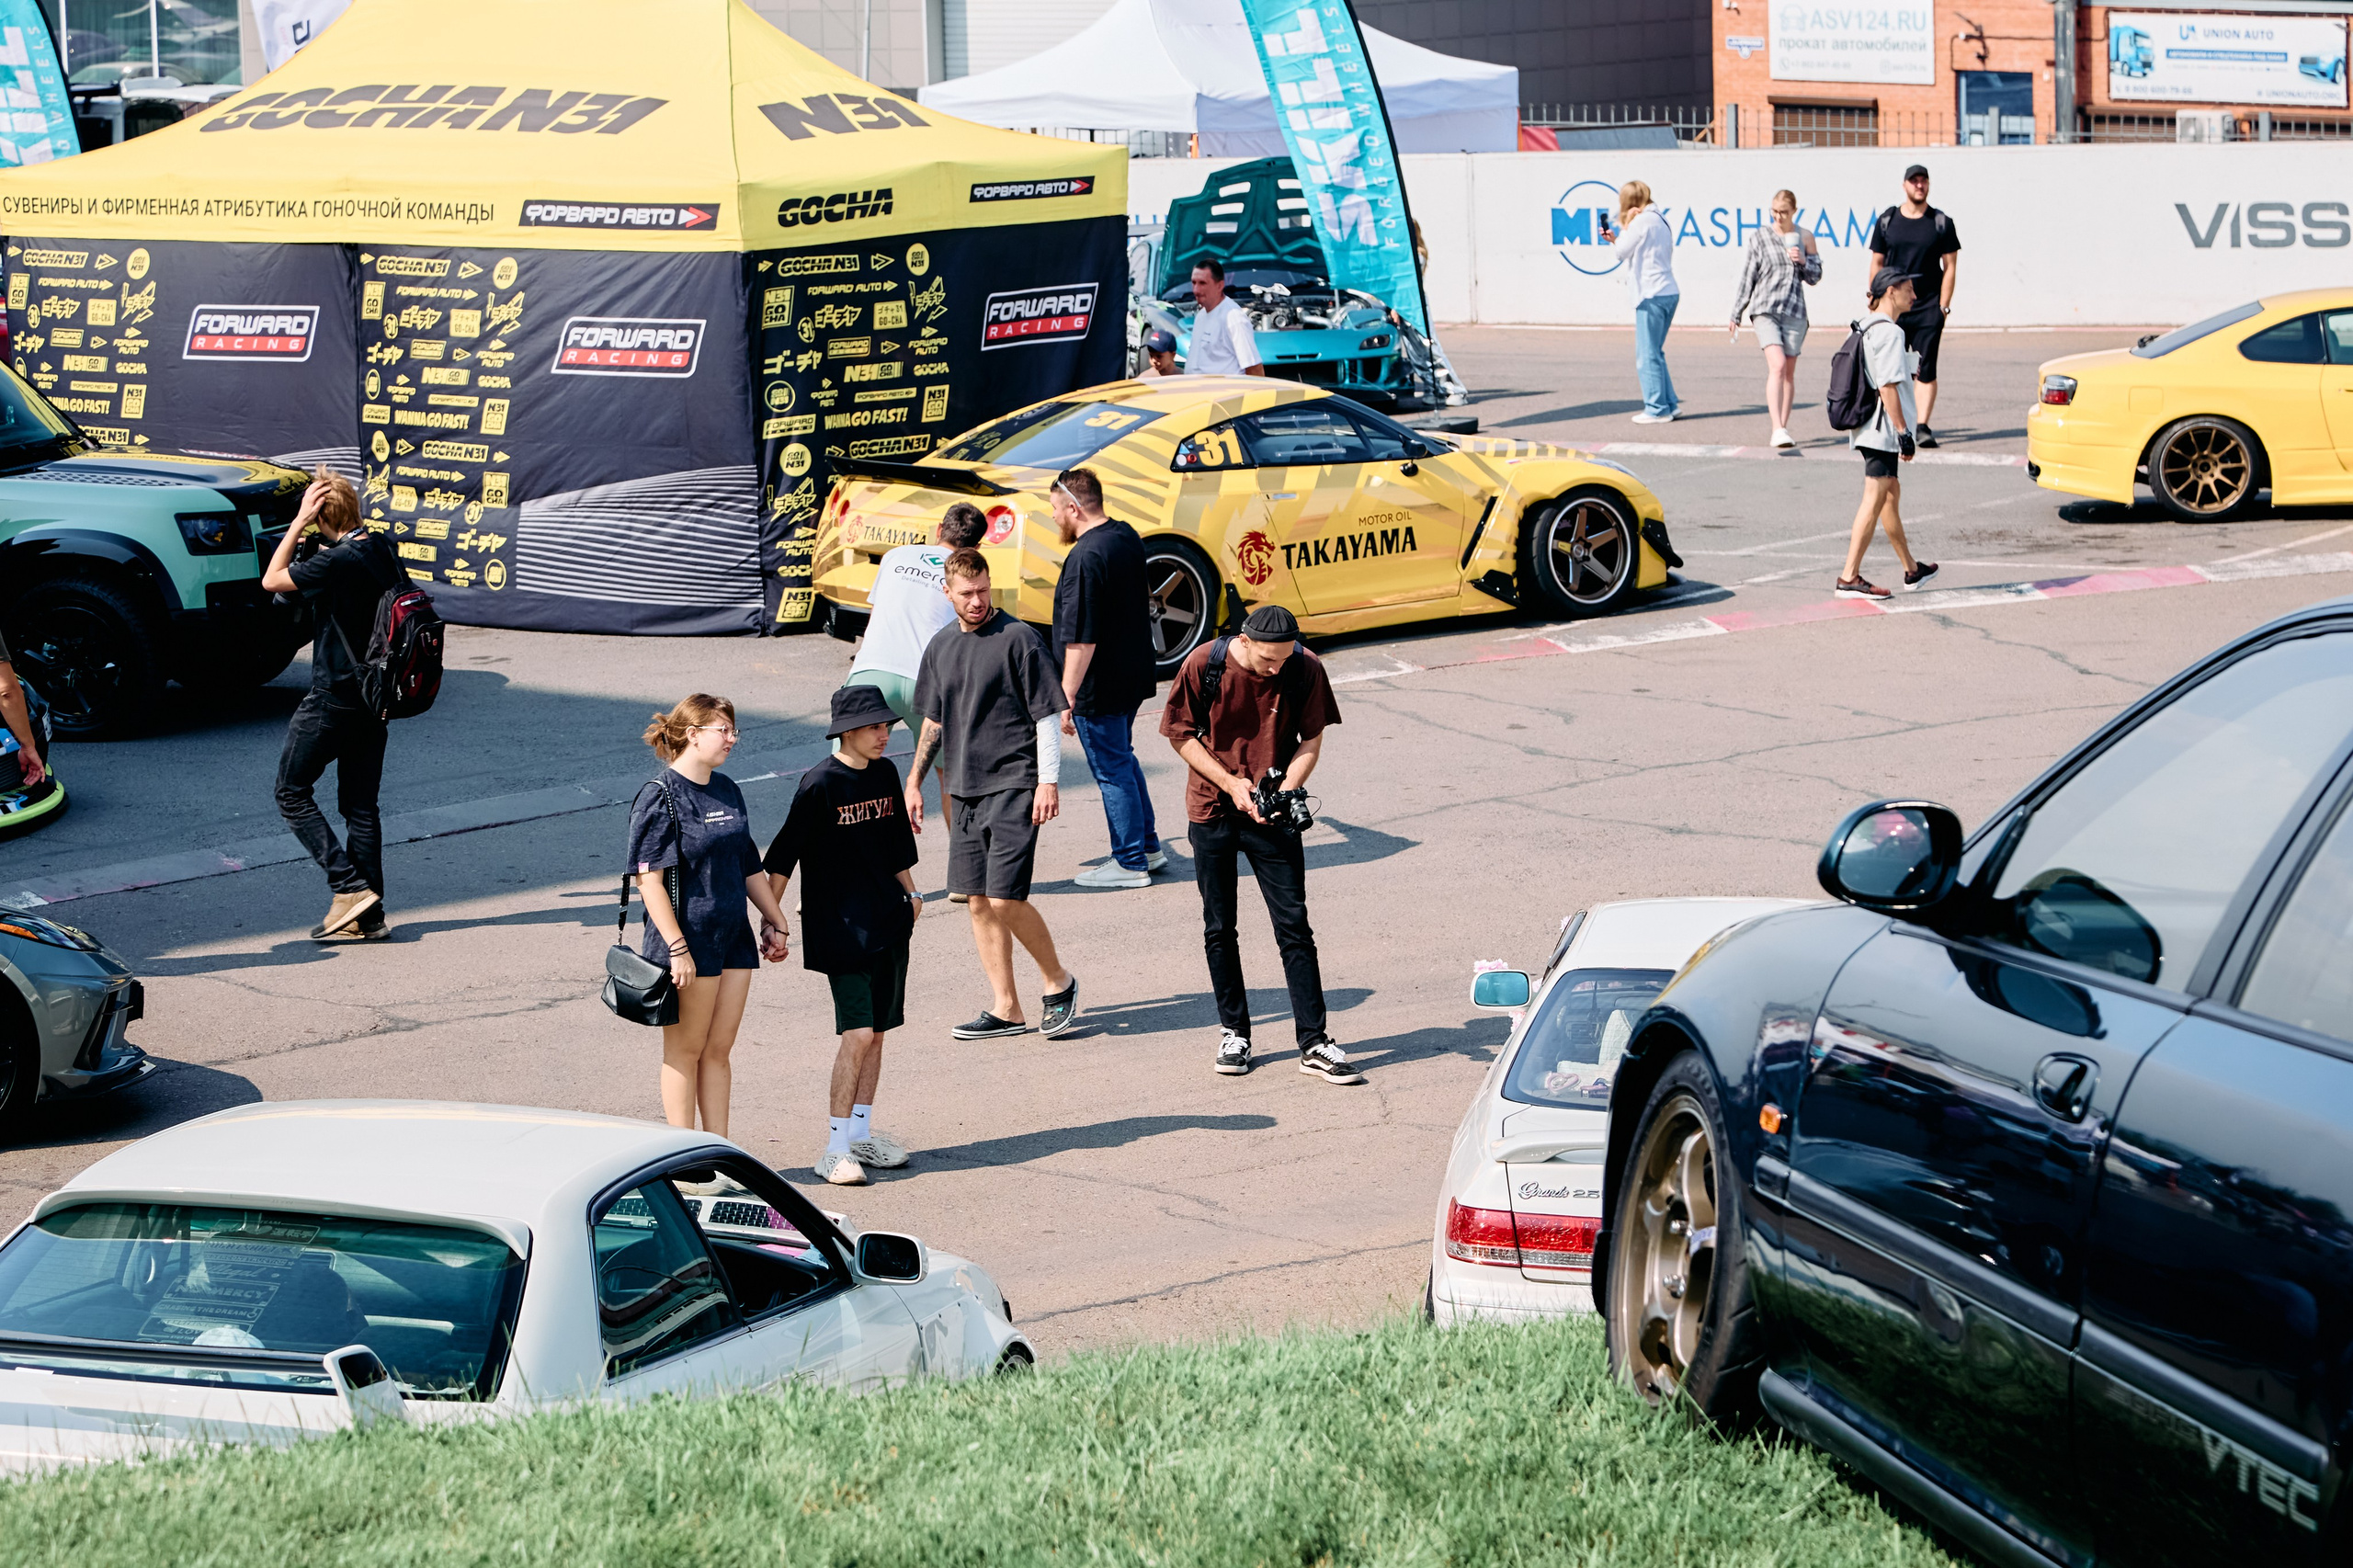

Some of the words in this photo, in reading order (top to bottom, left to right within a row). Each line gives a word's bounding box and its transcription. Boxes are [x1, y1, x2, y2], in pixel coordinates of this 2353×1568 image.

[1811, 9, 1927, 31] ASV124.RU
[2203, 28, 2241, 39] UNION
[2244, 29, 2275, 40] AUTO
[1779, 38, 1825, 51] прокат
[1832, 37, 1927, 51] автомобилей
[1324, 6, 1371, 118] WHEELS
[757, 92, 933, 141] N31
[1035, 181, 1068, 195] АВТО
[1364, 134, 1401, 248] FORGED
[3, 196, 84, 215] СУВЕНИРЫ
[88, 198, 97, 214] И
[102, 198, 199, 216] ФИРМЕННАЯ
[203, 199, 308, 218] АТРИБУТИКА
[313, 197, 402, 220] ГОНОЧНОЙ
[407, 201, 494, 224] КОМАНДЫ
[778, 187, 893, 227] GOCHA
[621, 208, 676, 226] АВТО
[2175, 202, 2351, 248] VISS
[807, 284, 853, 296] FORWARD
[855, 281, 881, 292] AUTO
[367, 299, 379, 307] GO
[766, 303, 786, 315] GO
[988, 293, 1093, 323] FORWARD
[194, 314, 311, 335] FORWARD
[879, 315, 904, 325] GO-CHA
[990, 316, 1085, 337] RACING
[196, 337, 301, 350] RACING
[566, 326, 696, 350] FORWARD
[909, 337, 949, 348] FORWARD
[566, 350, 683, 365] RACING
[915, 346, 938, 355] AUTO
[928, 390, 945, 400] N31
[70, 398, 84, 413] GO
[84, 399, 110, 415] FAST!
[427, 411, 442, 427] GO
[851, 412, 870, 426] GO
[871, 407, 908, 425] FAST!
[1084, 411, 1142, 431] 31
[850, 441, 903, 458] GOCHA
[903, 437, 928, 451] N31
[1194, 428, 1244, 467] 31
[1358, 513, 1394, 527] MOTOR
[1396, 511, 1412, 523] OIL
[864, 526, 927, 545] TAKAYAMA
[1280, 526, 1417, 571] TAKAYAMA
[901, 575, 929, 587] Detailing
[1518, 1180, 1570, 1199] Grande
[209, 1287, 269, 1300] MERCY
[198, 1305, 216, 1314] THE
[216, 1307, 248, 1317] DREAM
[2200, 1427, 2320, 1533] VTEC
